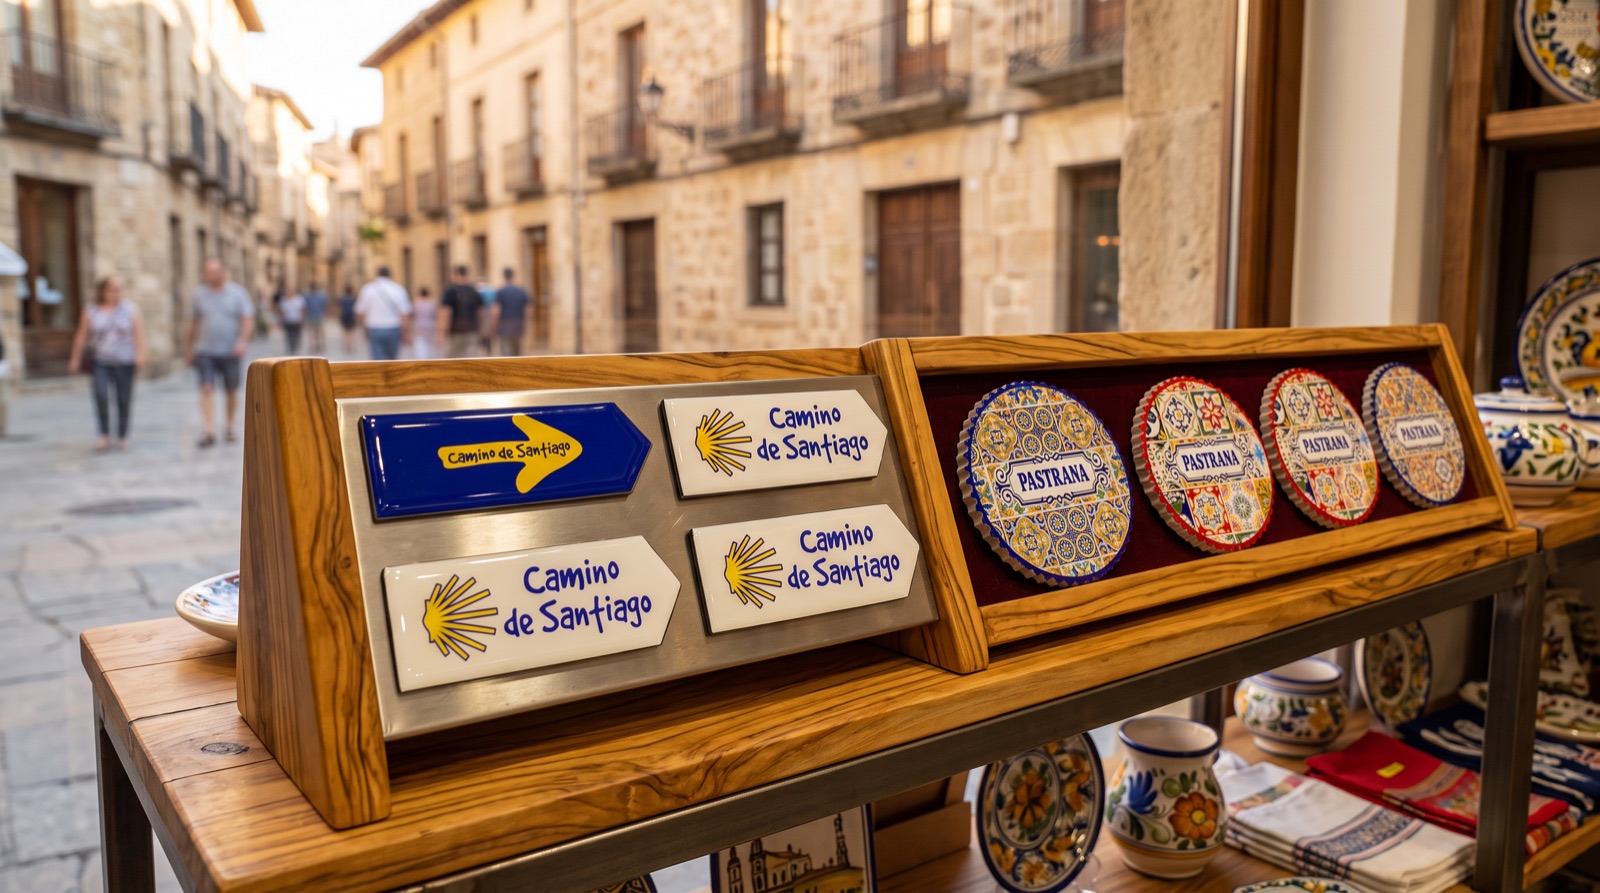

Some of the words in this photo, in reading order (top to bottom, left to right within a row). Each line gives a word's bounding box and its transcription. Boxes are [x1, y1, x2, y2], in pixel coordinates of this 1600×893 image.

[770, 405, 841, 429] Camino
[1302, 435, 1350, 454] PASTRANA
[1400, 423, 1441, 441] PASTRANA
[448, 448, 496, 464] Camino
[498, 446, 513, 459] de
[516, 441, 571, 459] Santiago
[757, 438, 780, 461] de
[783, 434, 868, 463] Santiago
[1181, 449, 1240, 472] PASTRANA
[1017, 463, 1090, 492] PASTRANA
[800, 524, 873, 553] Camino
[524, 559, 619, 594] Camino
[788, 565, 811, 589] de
[813, 555, 899, 587] Santiago
[504, 608, 534, 637] de
[539, 595, 651, 633] Santiago
